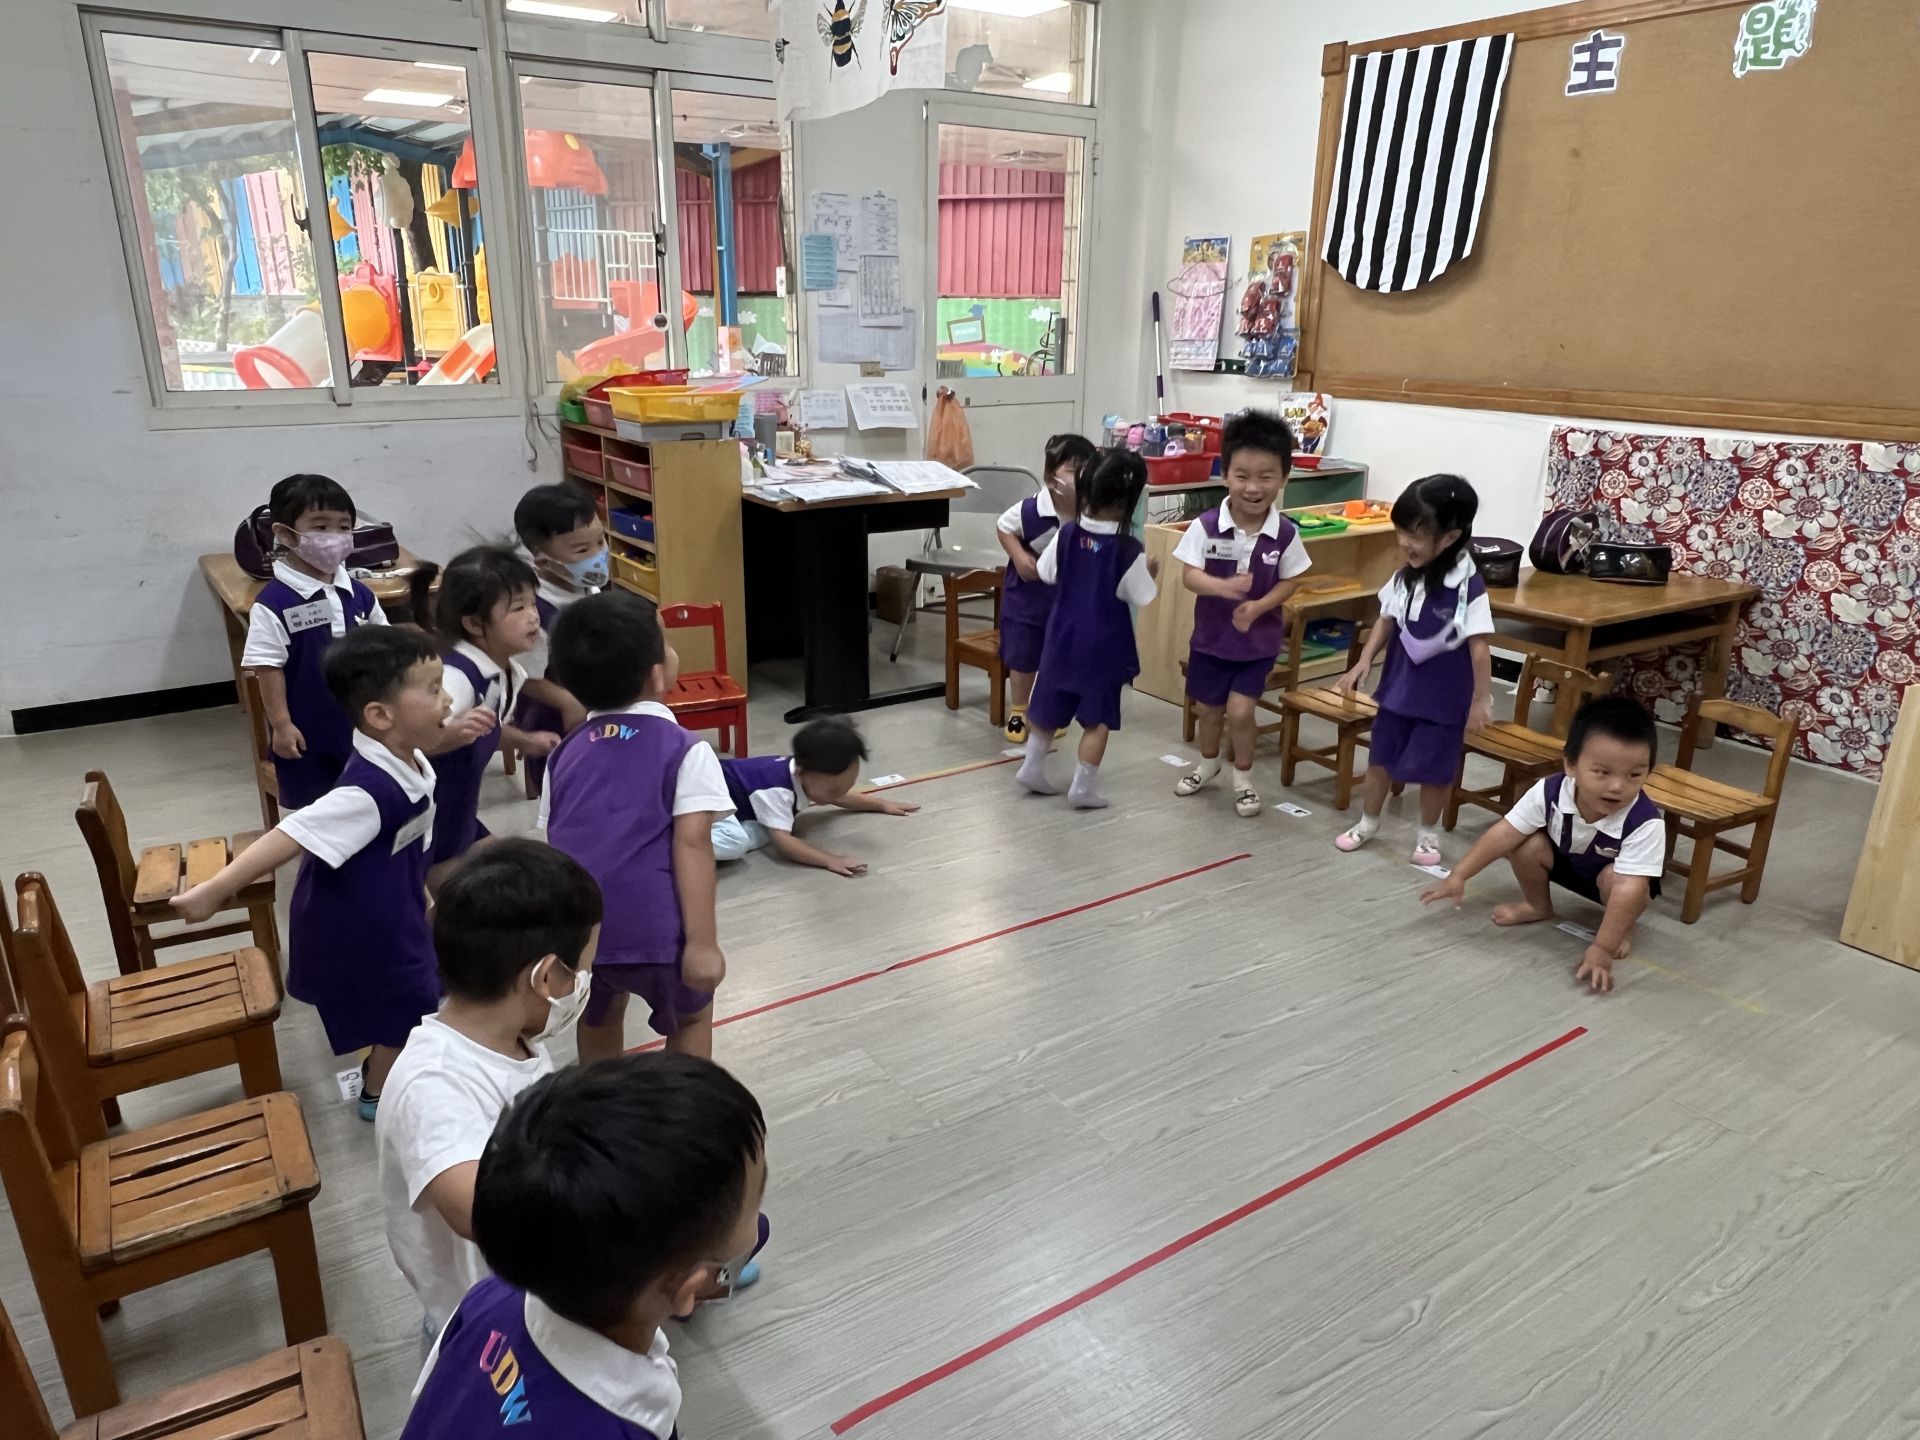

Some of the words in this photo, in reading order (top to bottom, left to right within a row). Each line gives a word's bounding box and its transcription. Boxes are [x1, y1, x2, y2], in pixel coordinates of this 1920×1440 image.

[1567, 32, 1624, 94] 主
[588, 723, 640, 742] UDW
[479, 1330, 533, 1426] UDW
